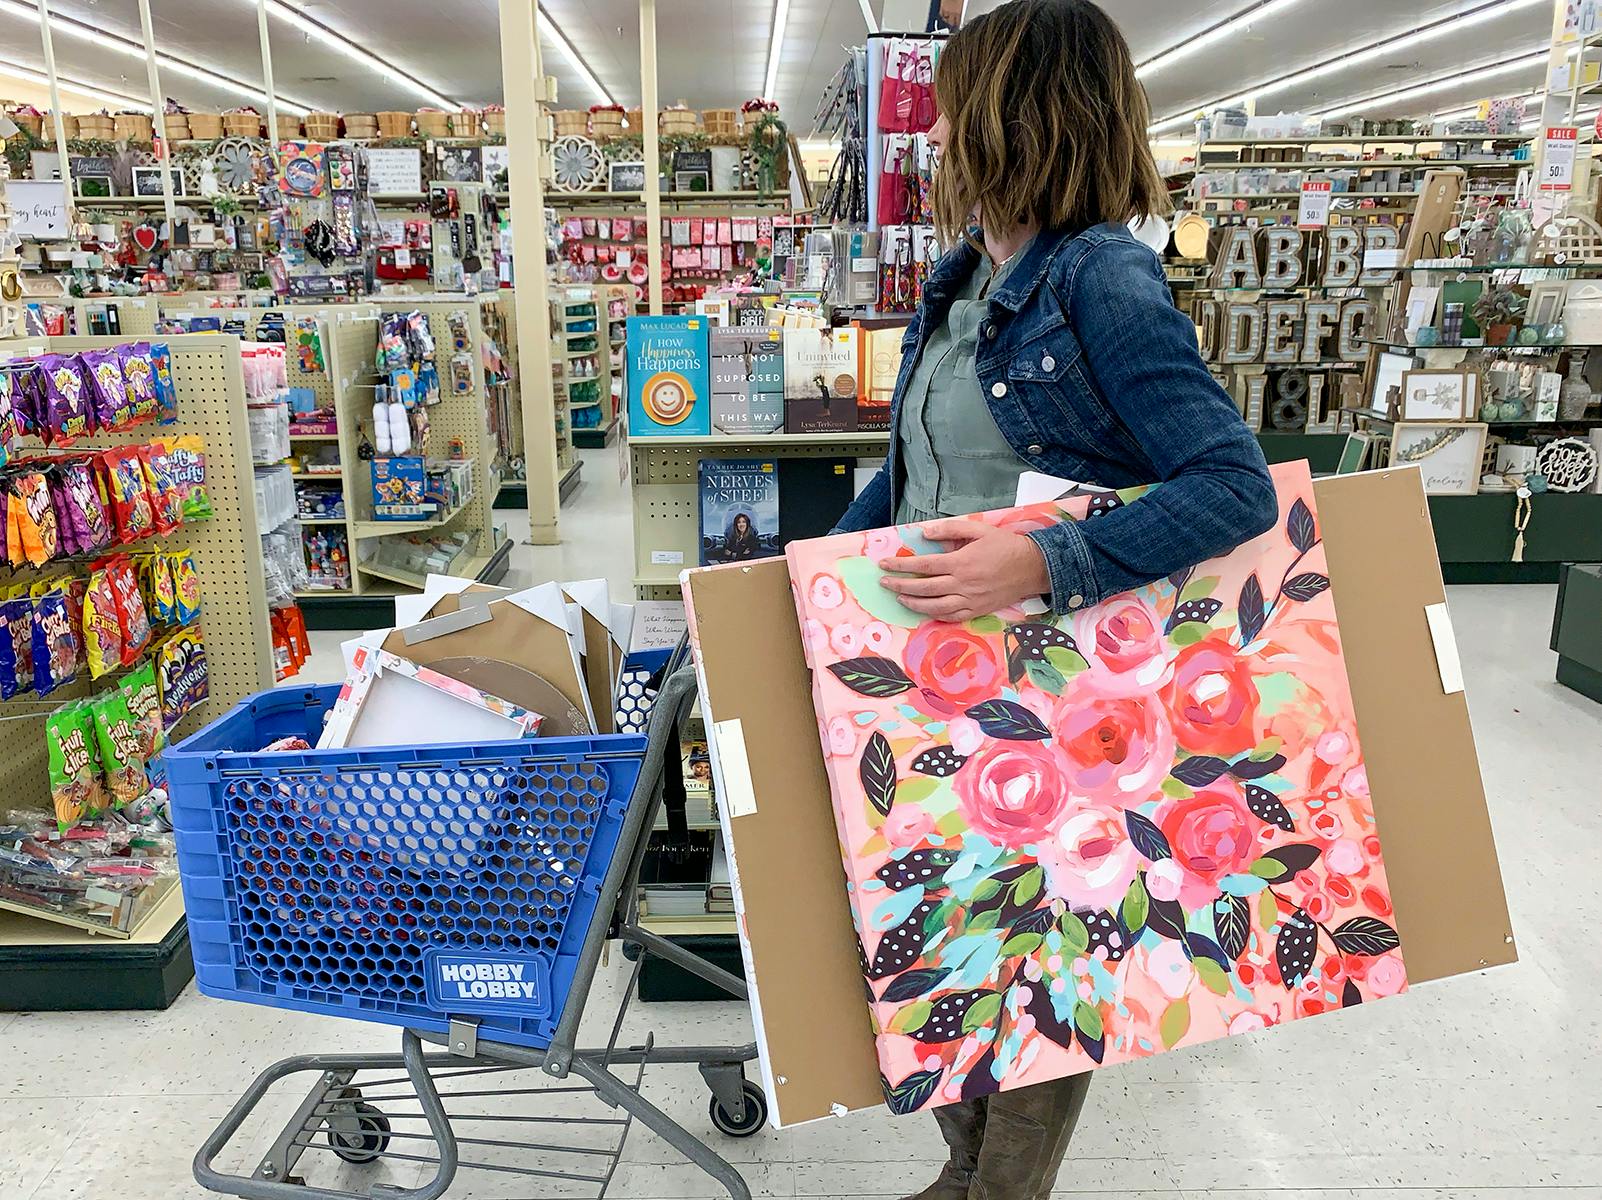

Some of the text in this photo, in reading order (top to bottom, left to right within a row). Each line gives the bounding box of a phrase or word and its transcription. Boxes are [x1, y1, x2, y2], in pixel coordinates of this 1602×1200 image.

[1552, 129, 1572, 138] SALE
[1549, 165, 1560, 177] 50
[1308, 182, 1325, 190] SALE
[33, 203, 57, 218] heart
[1306, 210, 1316, 220] 50
[640, 323, 659, 331] MAX
[741, 316, 765, 327] BIBLE
[657, 338, 683, 348] HOW
[641, 338, 695, 362] Happiness
[721, 354, 775, 363] IT'S NOT
[637, 357, 701, 373] Happens
[716, 374, 781, 382] SUPPOSED
[731, 394, 767, 402] TO BE
[720, 413, 778, 422] THIS WAY
[172, 464, 205, 485] Taffy
[706, 475, 774, 489] NERVES
[707, 489, 774, 504] of STEEL
[107, 719, 133, 746] Fruit
[58, 728, 85, 757] Fruit
[441, 964, 525, 982] HOBBY
[457, 981, 535, 999] LOBBY
